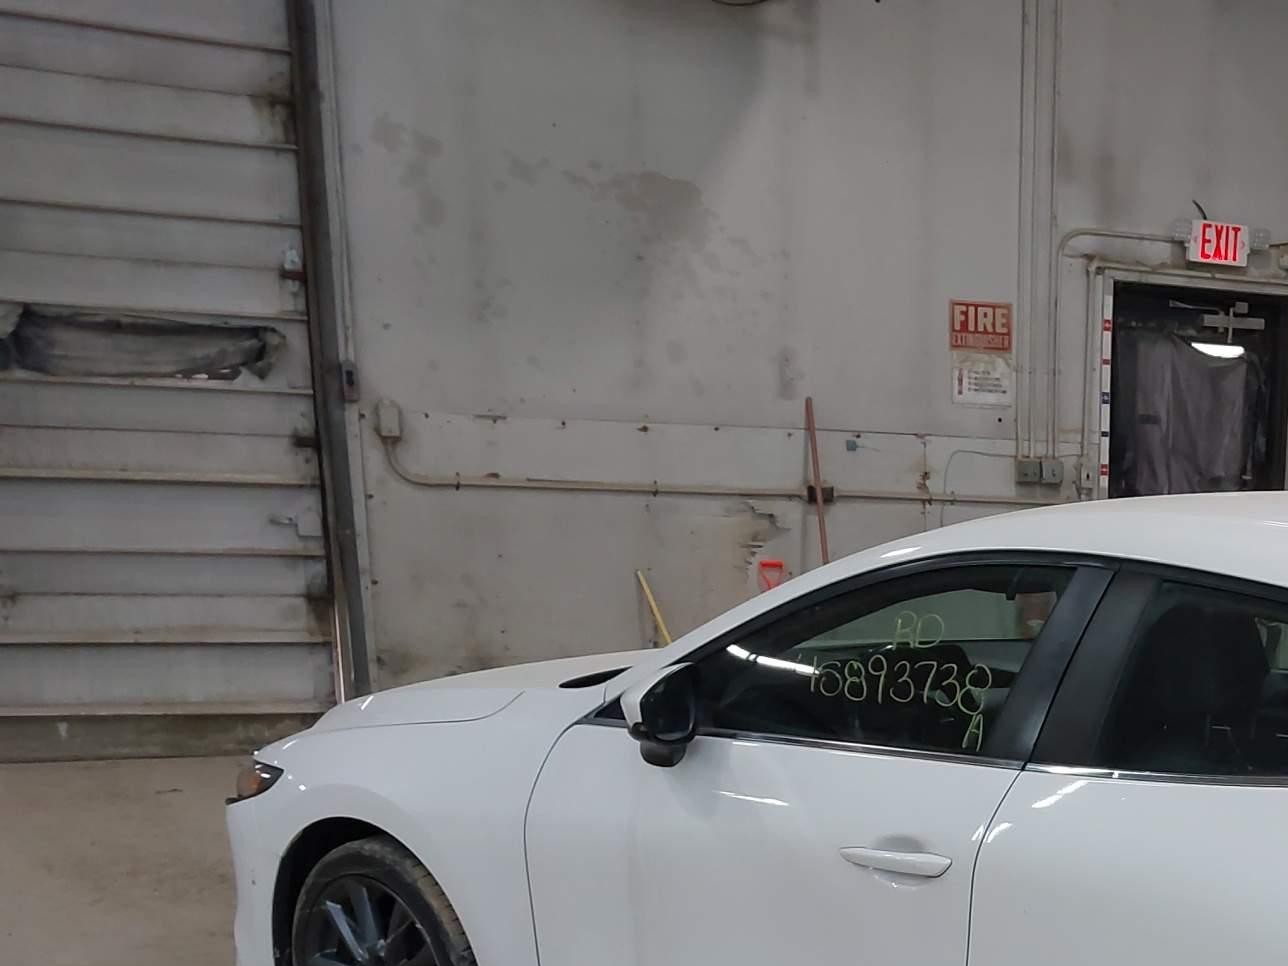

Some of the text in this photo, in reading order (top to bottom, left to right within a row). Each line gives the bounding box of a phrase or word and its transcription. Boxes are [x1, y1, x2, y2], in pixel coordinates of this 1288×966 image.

[1201, 223, 1241, 261] EXIT
[953, 304, 1009, 333] FIRE
[962, 714, 984, 752] A
